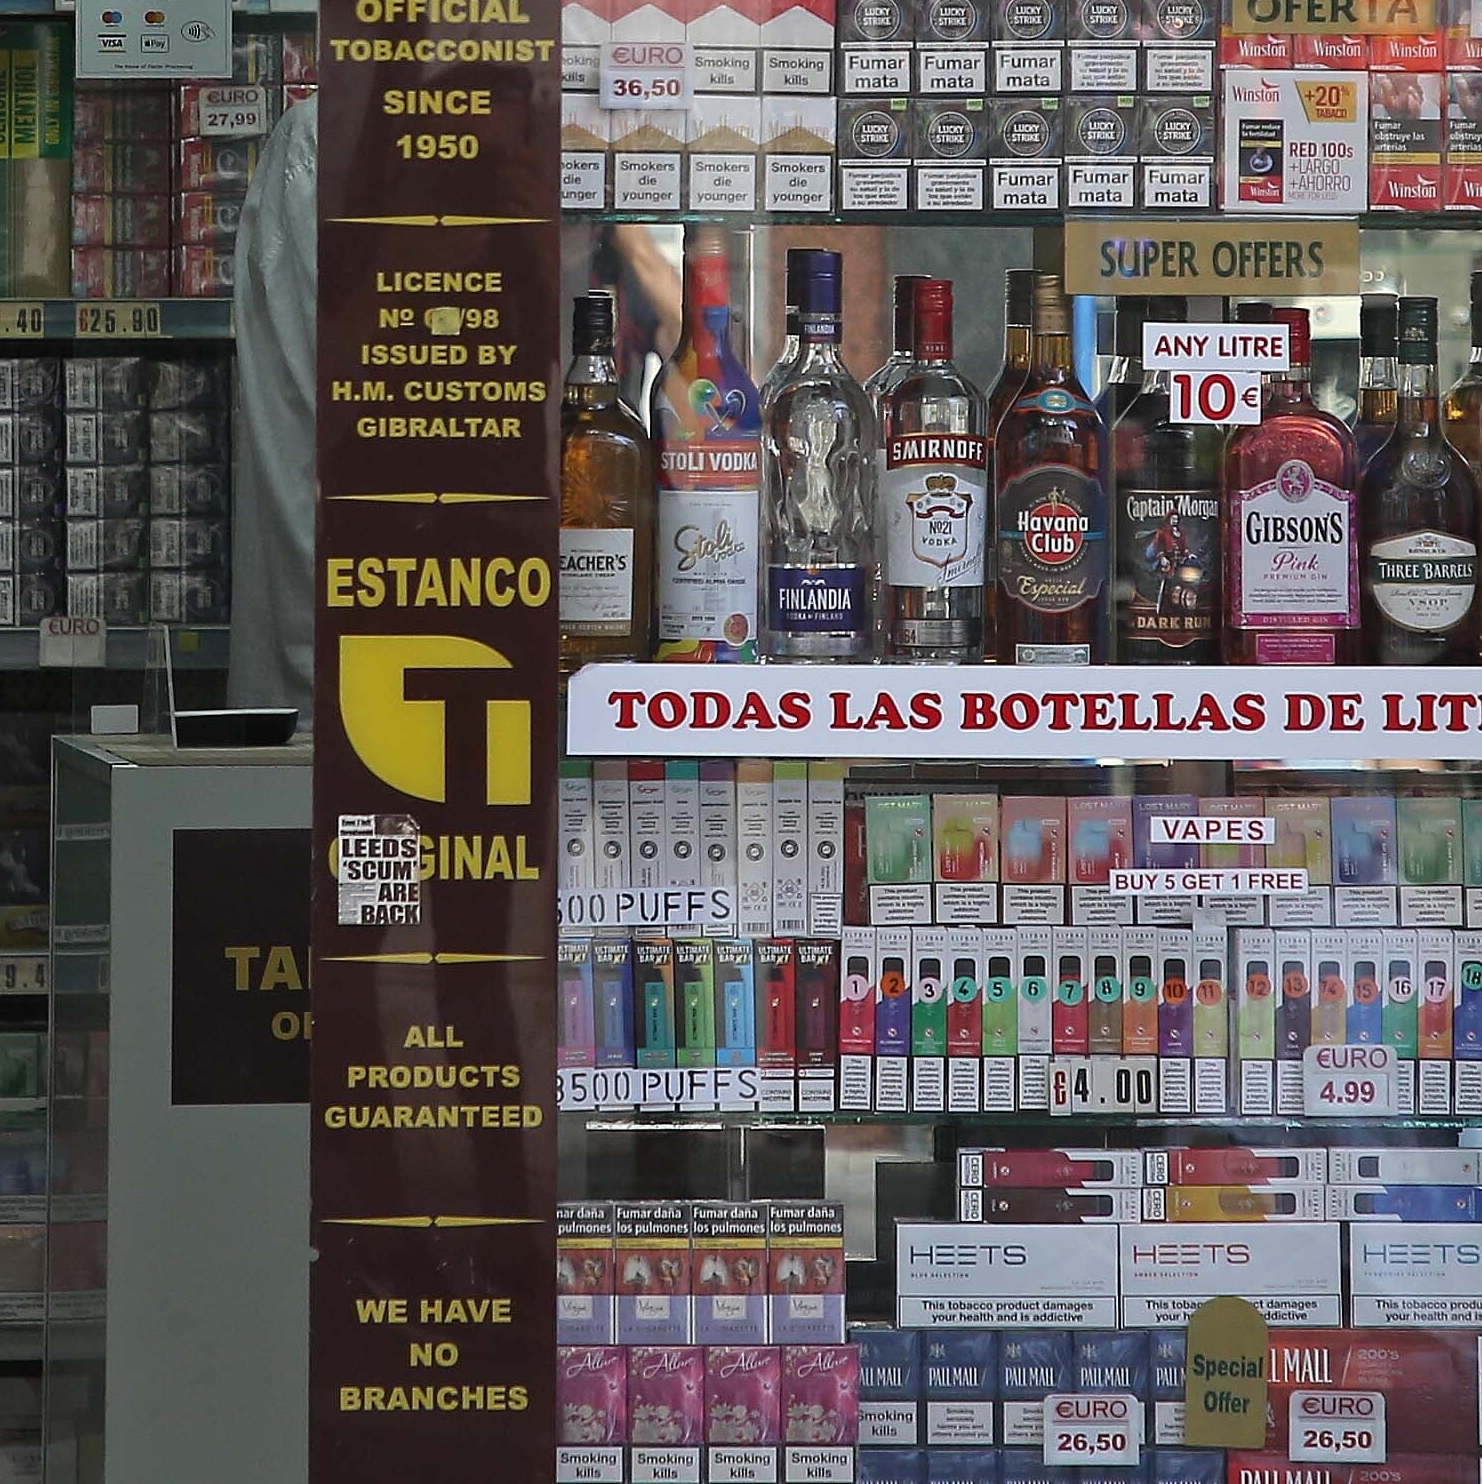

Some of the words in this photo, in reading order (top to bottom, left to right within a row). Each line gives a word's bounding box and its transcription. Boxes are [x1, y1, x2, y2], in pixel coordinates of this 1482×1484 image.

[330, 38, 555, 63] TOBACCONIST
[849, 56, 905, 70] Fumar
[612, 78, 681, 99] 36,50
[855, 75, 899, 89] mata
[382, 90, 492, 116] SINCE
[206, 111, 257, 128] 27,99
[396, 133, 480, 160] 1950
[1289, 142, 1319, 158] RED
[1321, 142, 1354, 158] 100s
[771, 161, 826, 175] Smokers
[772, 190, 823, 205] younger
[1100, 239, 1200, 278] SUPER
[1212, 240, 1324, 278] OFFERS
[376, 271, 503, 293] LICENCE
[360, 344, 468, 365] ISSUED
[478, 344, 518, 365] BY
[1154, 335, 1210, 358] ANY
[1218, 334, 1283, 358] LITRE
[331, 380, 394, 402] H.M.
[403, 380, 547, 402] CUSTOMS
[356, 417, 522, 438] GIBRALTAR
[661, 451, 706, 472] STOLI
[709, 450, 758, 472] VODKA
[892, 437, 984, 462] SMIRNOFF
[1018, 510, 1089, 533] Havana
[1245, 511, 1343, 547] GIBSON'S
[1031, 532, 1075, 554] Club
[1271, 551, 1319, 572] Pink
[1379, 562, 1421, 580] THREE
[1423, 561, 1473, 581] BARRELS
[326, 556, 552, 608] ESTANCO
[779, 588, 852, 611] FINLANDIA
[608, 689, 812, 733] TODAS
[828, 689, 944, 733] LAS
[958, 689, 1268, 733] BOTELLAS
[1284, 690, 1361, 734] DE
[1161, 818, 1265, 841] VAPES
[328, 833, 541, 881] GINAL
[341, 838, 418, 858] LEEDS
[378, 883, 419, 902] ARE
[1115, 873, 1160, 891] BUY
[1165, 873, 1177, 891] 5
[1181, 873, 1226, 891] GET
[1231, 873, 1240, 891] 1
[1247, 872, 1304, 891] FREE
[360, 905, 421, 925] BACK
[225, 946, 312, 991] TA
[403, 1025, 465, 1049] ALL
[347, 1065, 521, 1089] PRODUCTS
[642, 1069, 758, 1102] PUFFS
[1320, 1080, 1375, 1104] 4.99
[324, 1104, 544, 1129] GUARANTEED
[1133, 1243, 1250, 1265] HEETS
[355, 1298, 409, 1324] WE
[419, 1298, 513, 1324] HAVE
[408, 1342, 459, 1368] NO
[1193, 1354, 1264, 1382] Special
[339, 1385, 530, 1412] BRANCHES
[1204, 1390, 1251, 1415] Offer
